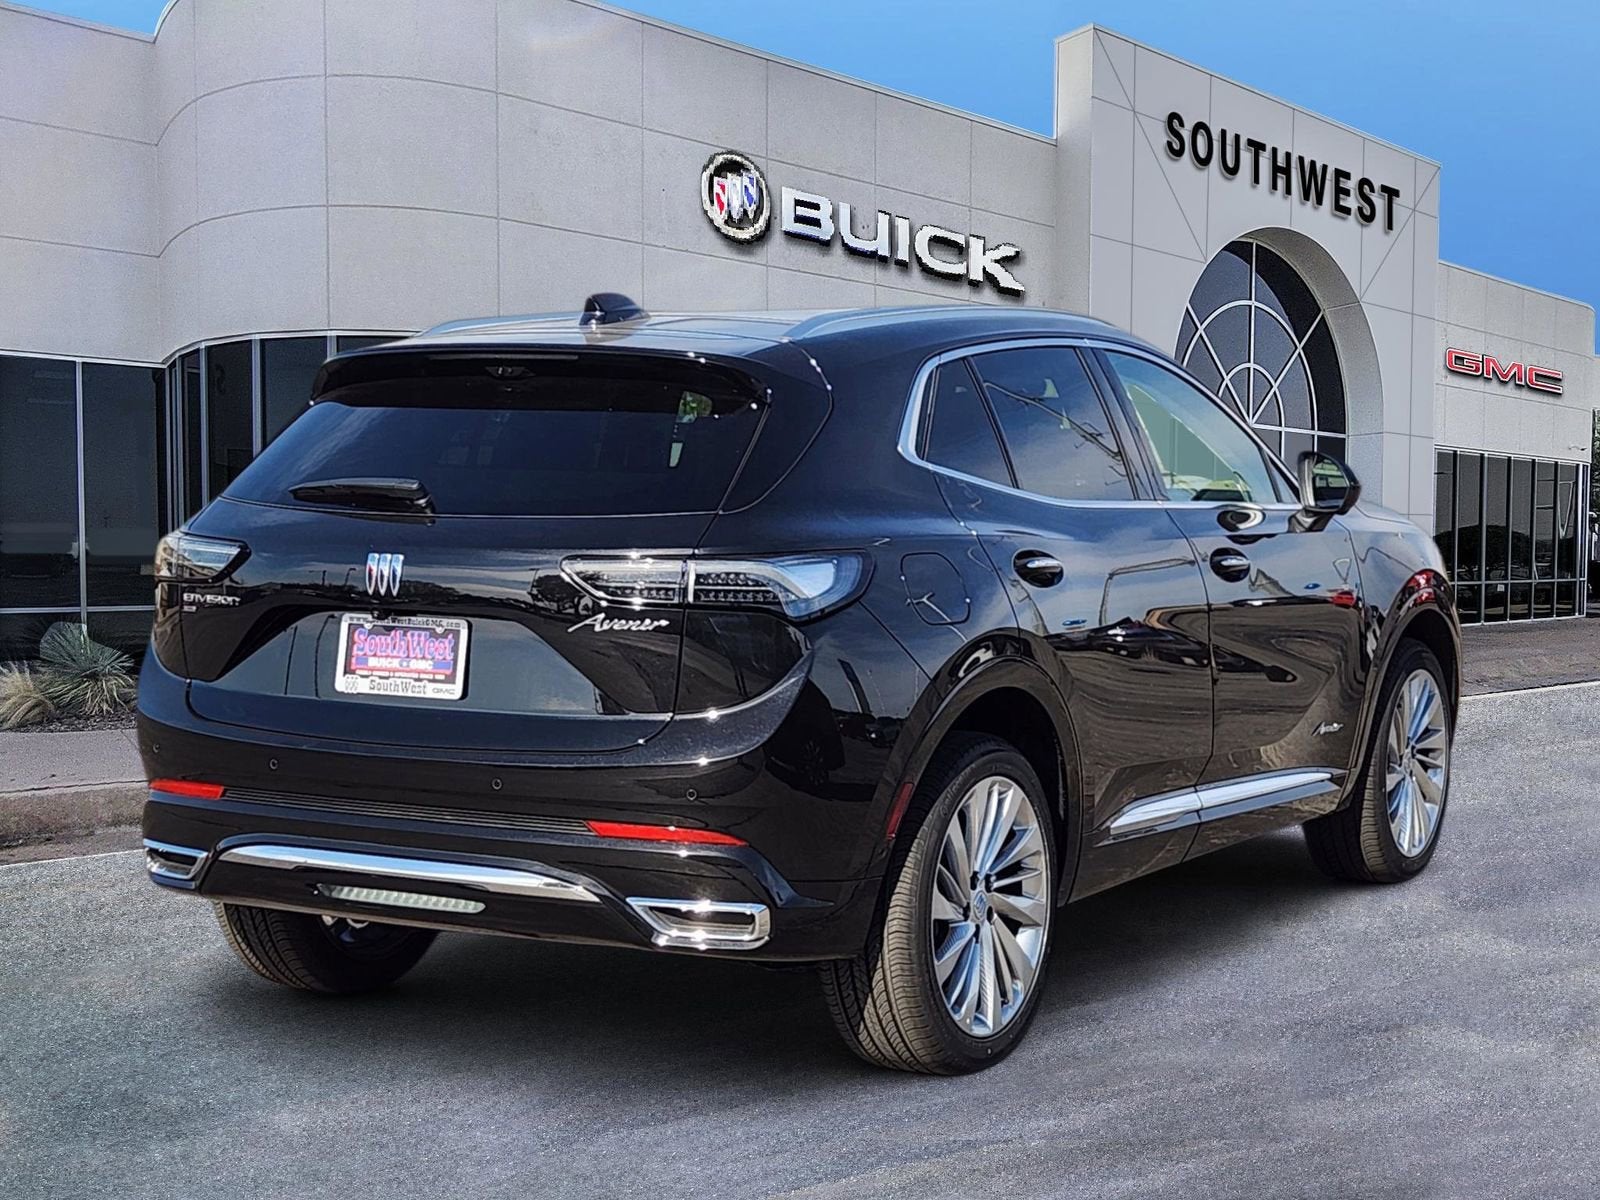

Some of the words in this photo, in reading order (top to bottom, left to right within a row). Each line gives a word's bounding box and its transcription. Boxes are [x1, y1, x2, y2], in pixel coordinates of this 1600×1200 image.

[1166, 111, 1400, 232] SOUTHWEST
[782, 186, 1025, 296] BUICK
[1446, 347, 1563, 395] GMC
[353, 628, 456, 661] SouthWest
[369, 679, 428, 695] SouthWest
[432, 687, 456, 695] GMC
